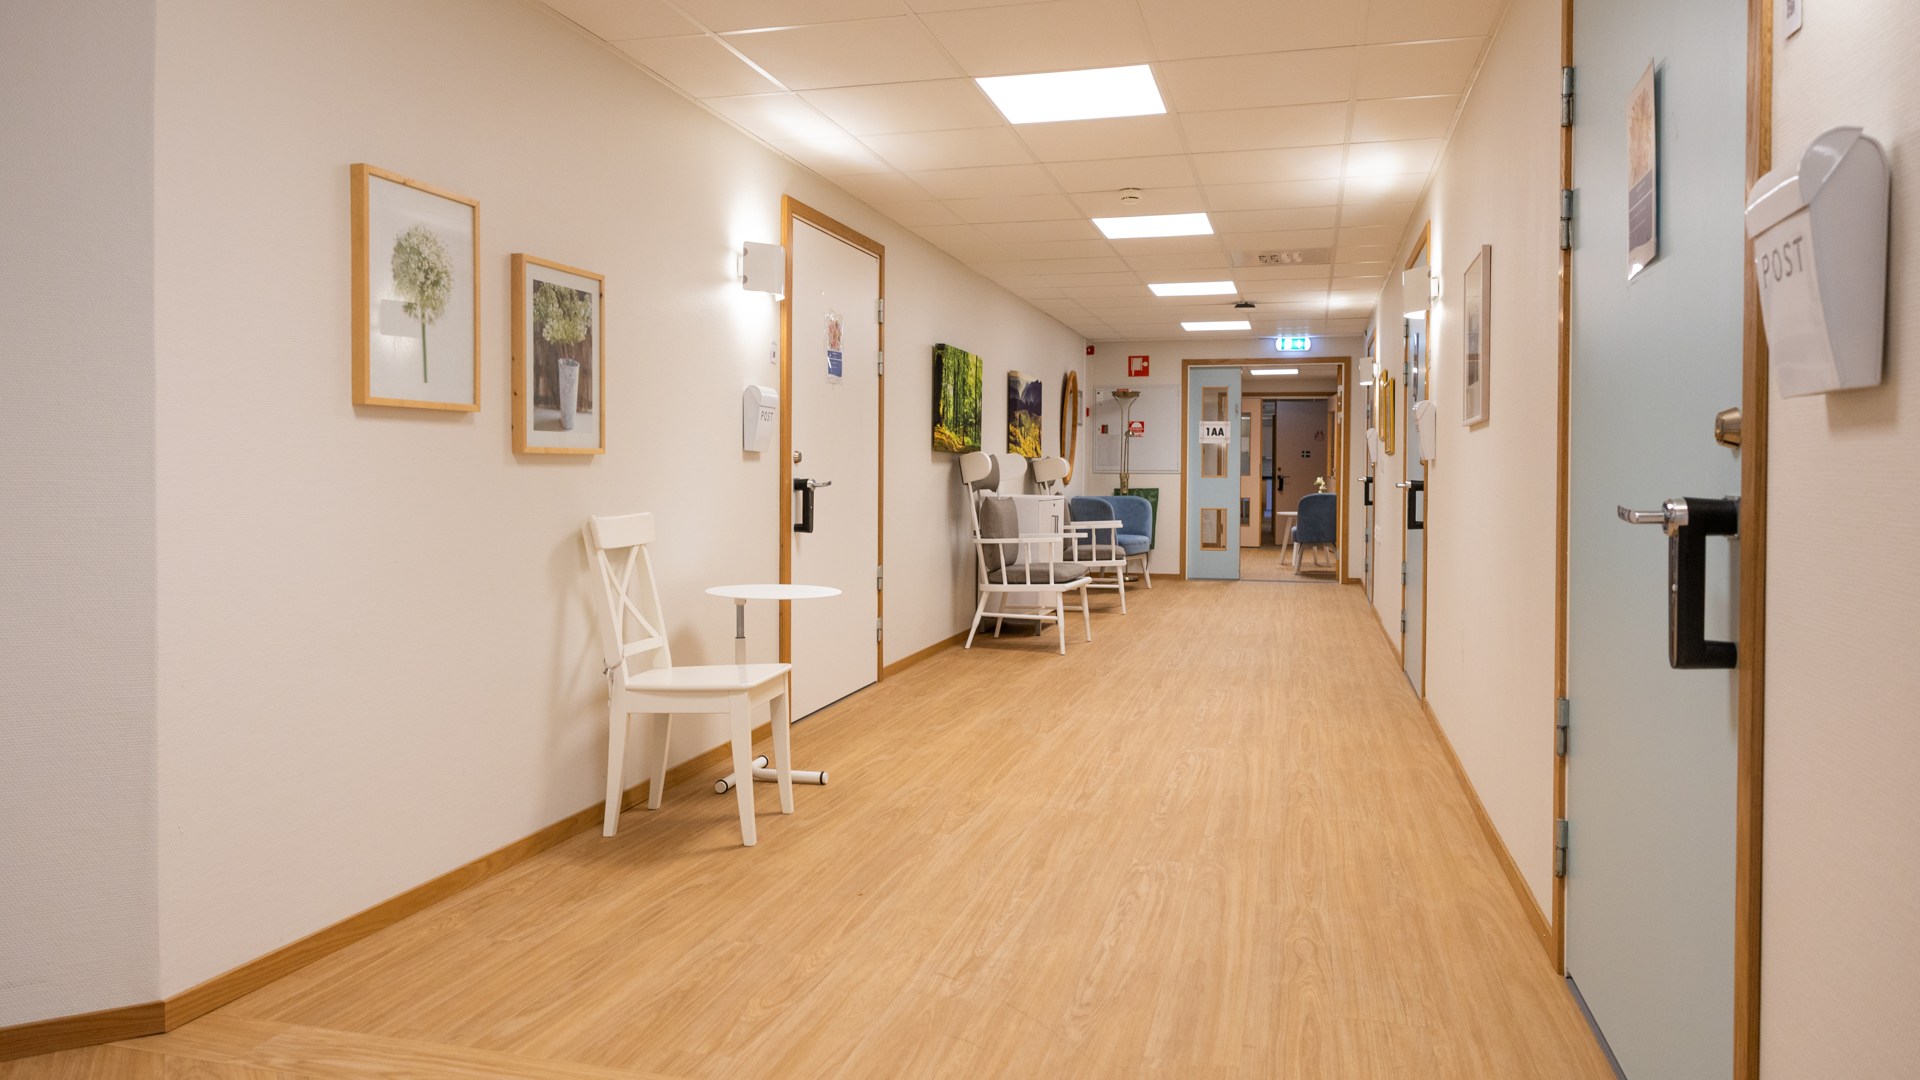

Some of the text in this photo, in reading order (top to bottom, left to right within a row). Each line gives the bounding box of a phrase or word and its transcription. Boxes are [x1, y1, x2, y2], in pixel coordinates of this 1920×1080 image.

[1761, 235, 1803, 289] POST
[760, 410, 774, 422] POST
[1206, 427, 1225, 436] 1AA
